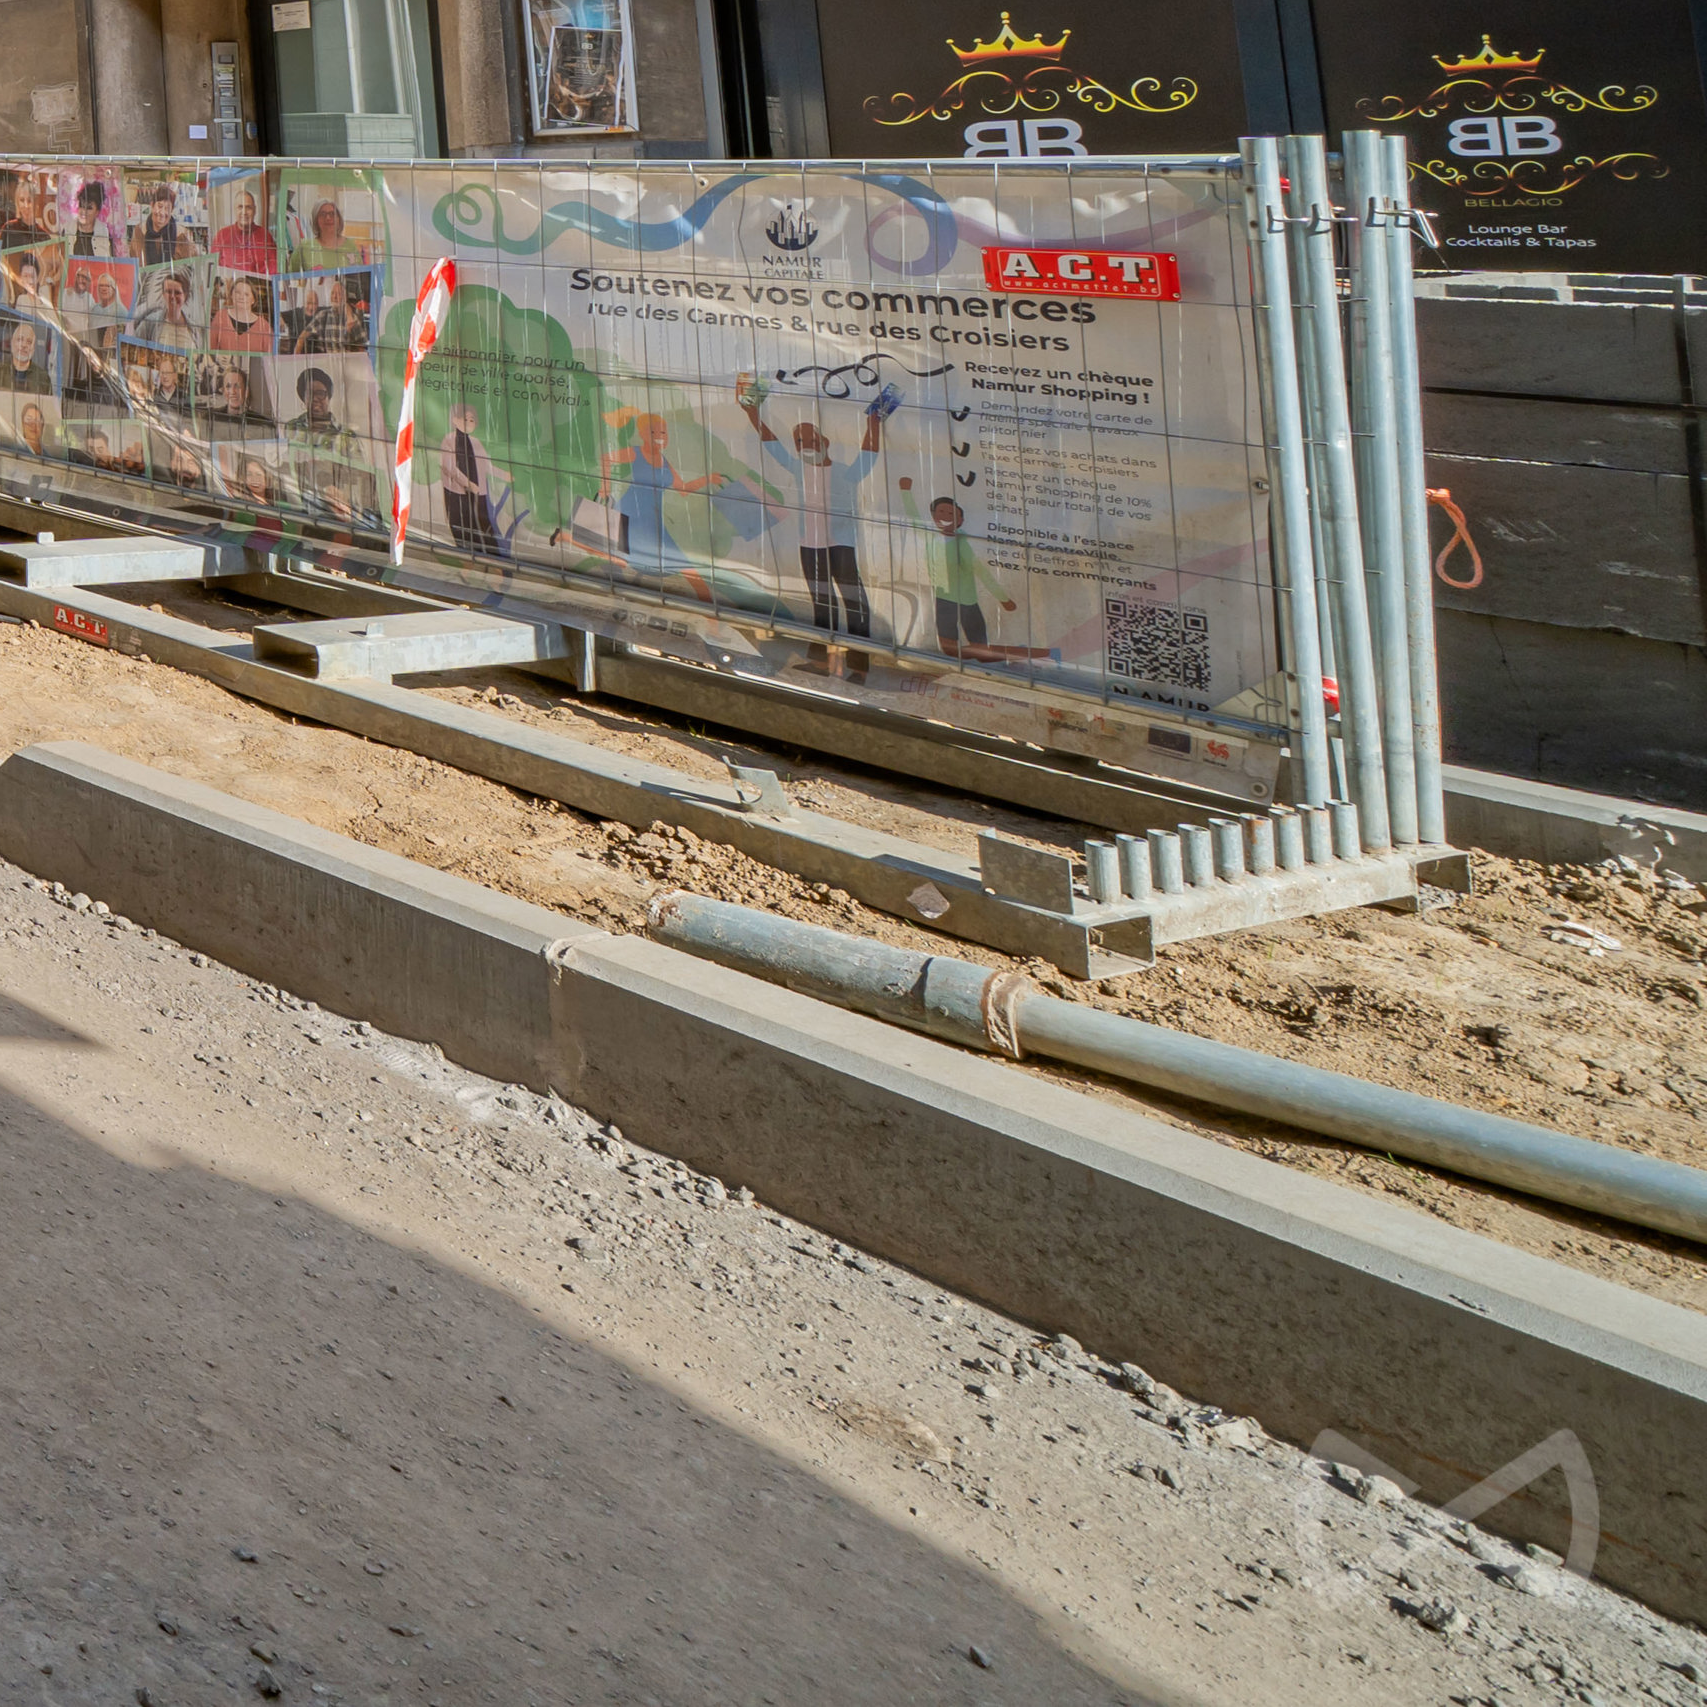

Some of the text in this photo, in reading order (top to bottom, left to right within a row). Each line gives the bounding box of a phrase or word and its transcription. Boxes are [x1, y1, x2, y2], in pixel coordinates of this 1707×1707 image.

[1464, 197, 1564, 208] BELLAGIO
[1468, 223, 1568, 237] Lounge Bar
[1445, 236, 1598, 249] Cocktails & Tapas
[762, 255, 823, 269] NAMUR
[1002, 252, 1158, 284] A.C.T.
[763, 268, 825, 281] CAPITALE
[1003, 279, 1159, 295] www.actmettet.be
[570, 267, 1098, 325] Soutenez vos commerces
[588, 302, 1071, 353] rue des Carmes & rue des Croisiers
[563, 357, 586, 371] un
[512, 372, 571, 390] apaisé,
[964, 361, 1155, 390] Recevez un chèque
[512, 390, 581, 407] convivial
[971, 377, 1151, 407] Namur Shopping !
[980, 400, 1154, 427] Demandez votre carte de
[1077, 462, 1140, 479] Croisiers
[1120, 455, 1158, 469] dans
[1041, 473, 1061, 485] un
[1104, 493, 1123, 505] de
[1126, 495, 1153, 509] 10%
[1106, 506, 1125, 518] de
[1127, 511, 1153, 522] vos
[987, 522, 1059, 541] Disponible
[1061, 532, 1071, 544] à
[987, 559, 1158, 592] chez vos commerçants
[55, 606, 107, 636] A.C.T.
